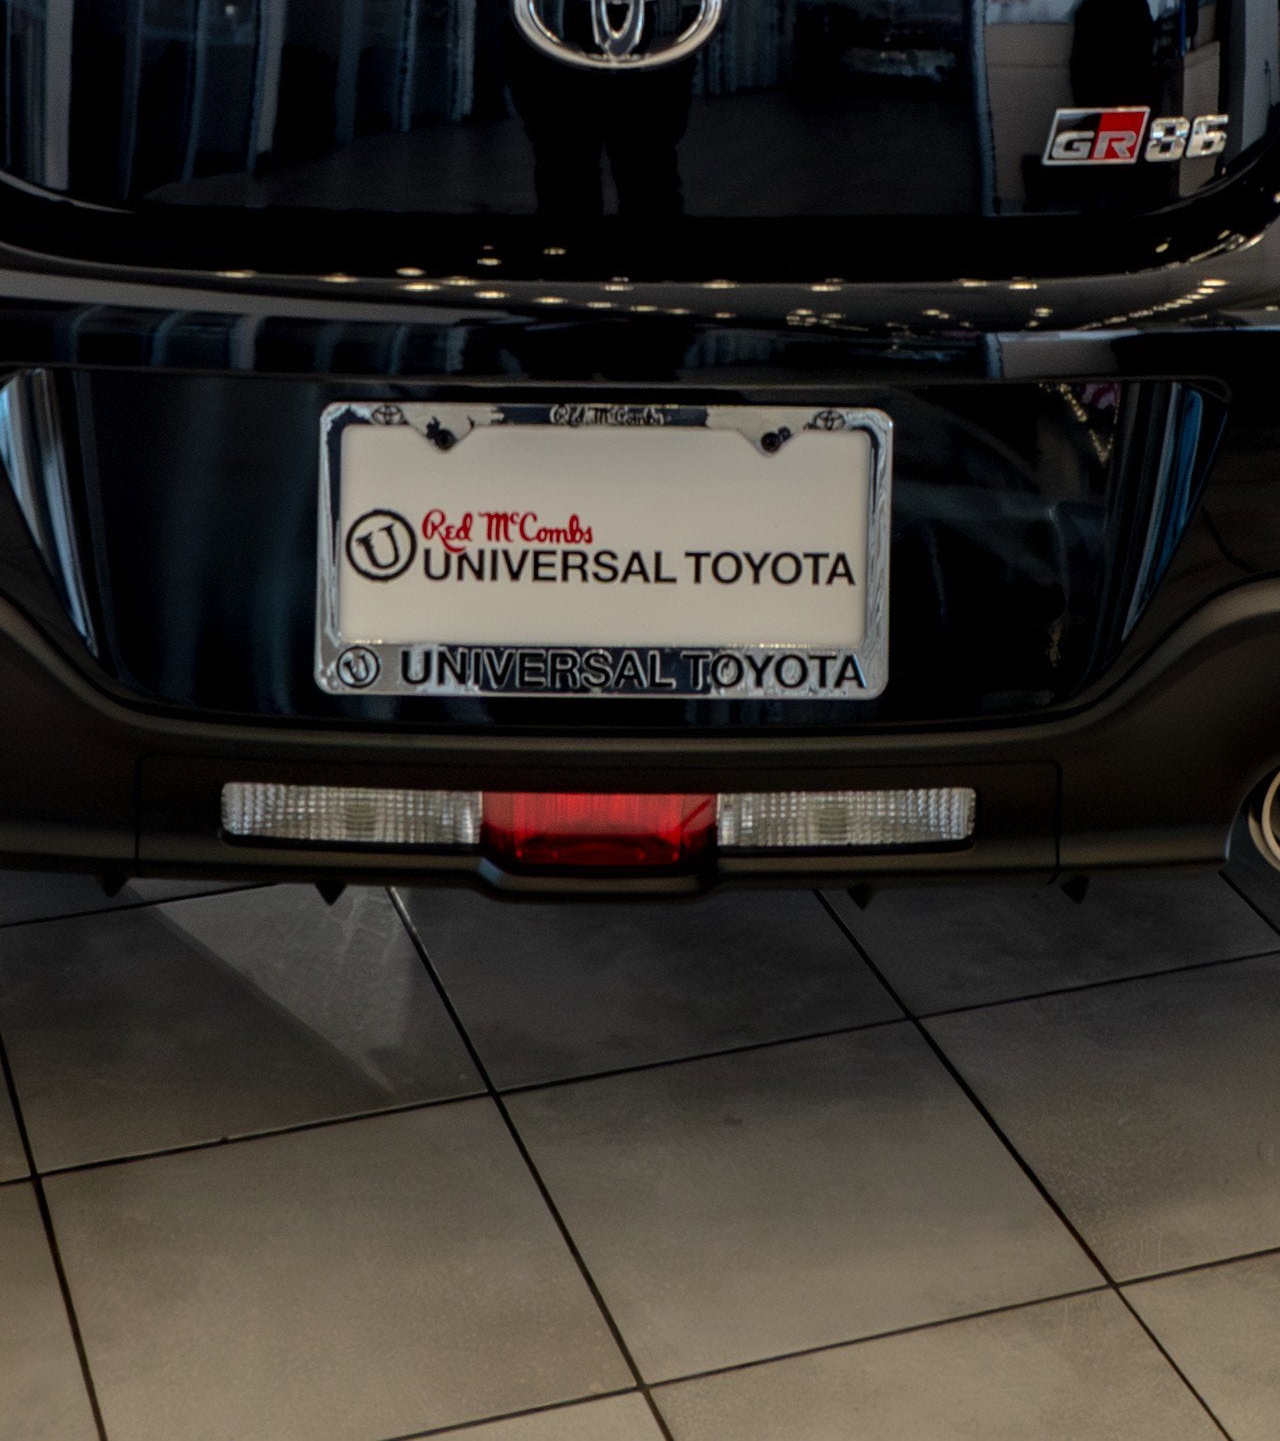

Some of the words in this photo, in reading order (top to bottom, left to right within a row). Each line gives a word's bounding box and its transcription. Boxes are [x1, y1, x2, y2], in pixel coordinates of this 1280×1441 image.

[422, 508, 472, 554] Red
[480, 510, 594, 544] McCombs
[423, 548, 678, 585] UNIVERSAL
[685, 551, 857, 586] TOYOTA
[400, 648, 678, 690] UNIVERSAL
[683, 652, 868, 690] TOYOTA
